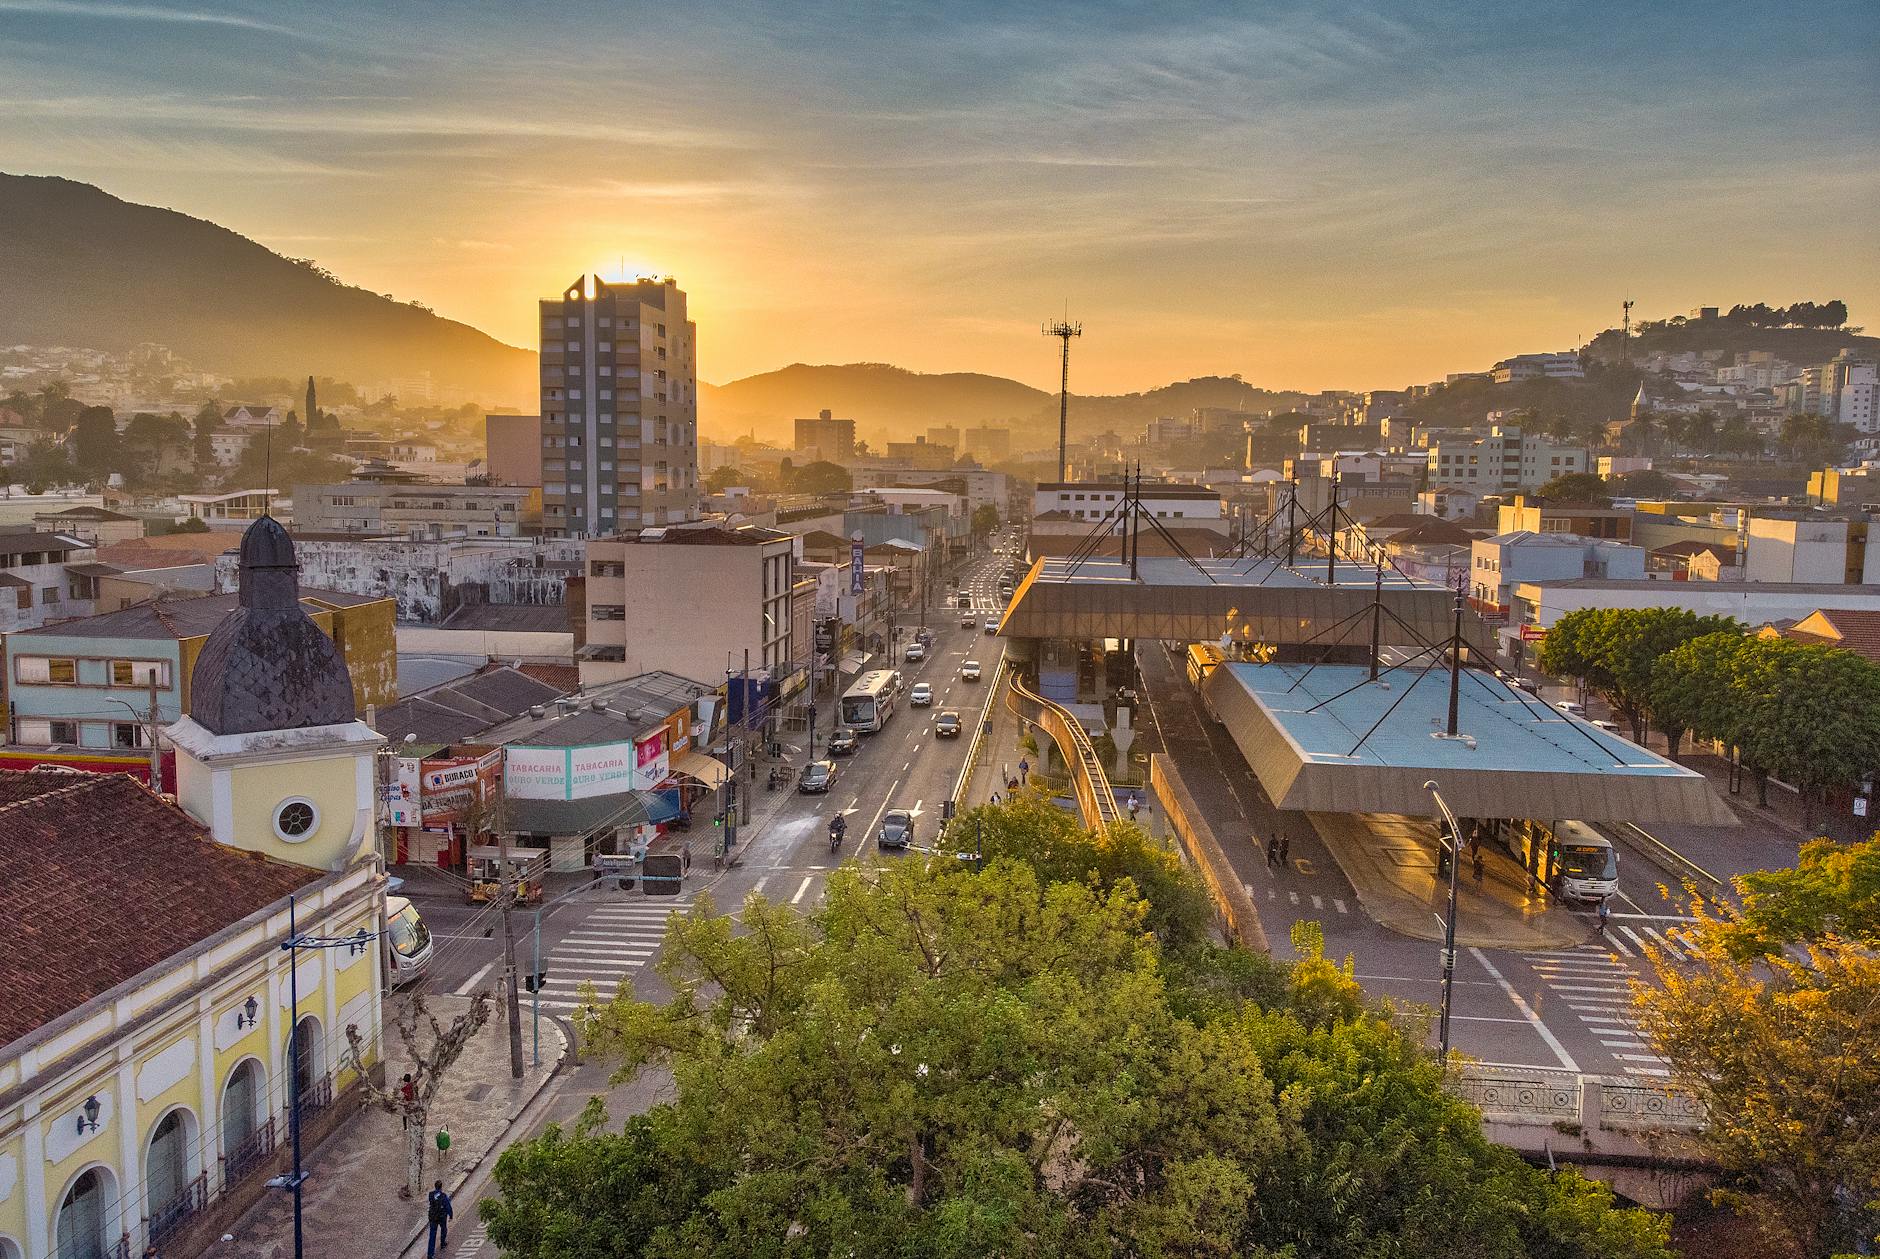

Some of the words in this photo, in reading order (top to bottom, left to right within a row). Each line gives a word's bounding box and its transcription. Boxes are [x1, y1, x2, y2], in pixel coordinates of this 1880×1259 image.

[852, 548, 863, 591] BAHIA
[511, 764, 561, 774] TABACARIA
[575, 759, 624, 772] TABACARIA
[444, 769, 474, 783] BURACO
[508, 775, 531, 784] OURO
[535, 776, 565, 785] VERDE
[572, 773, 596, 785] OURO
[600, 769, 628, 781] VERDE
